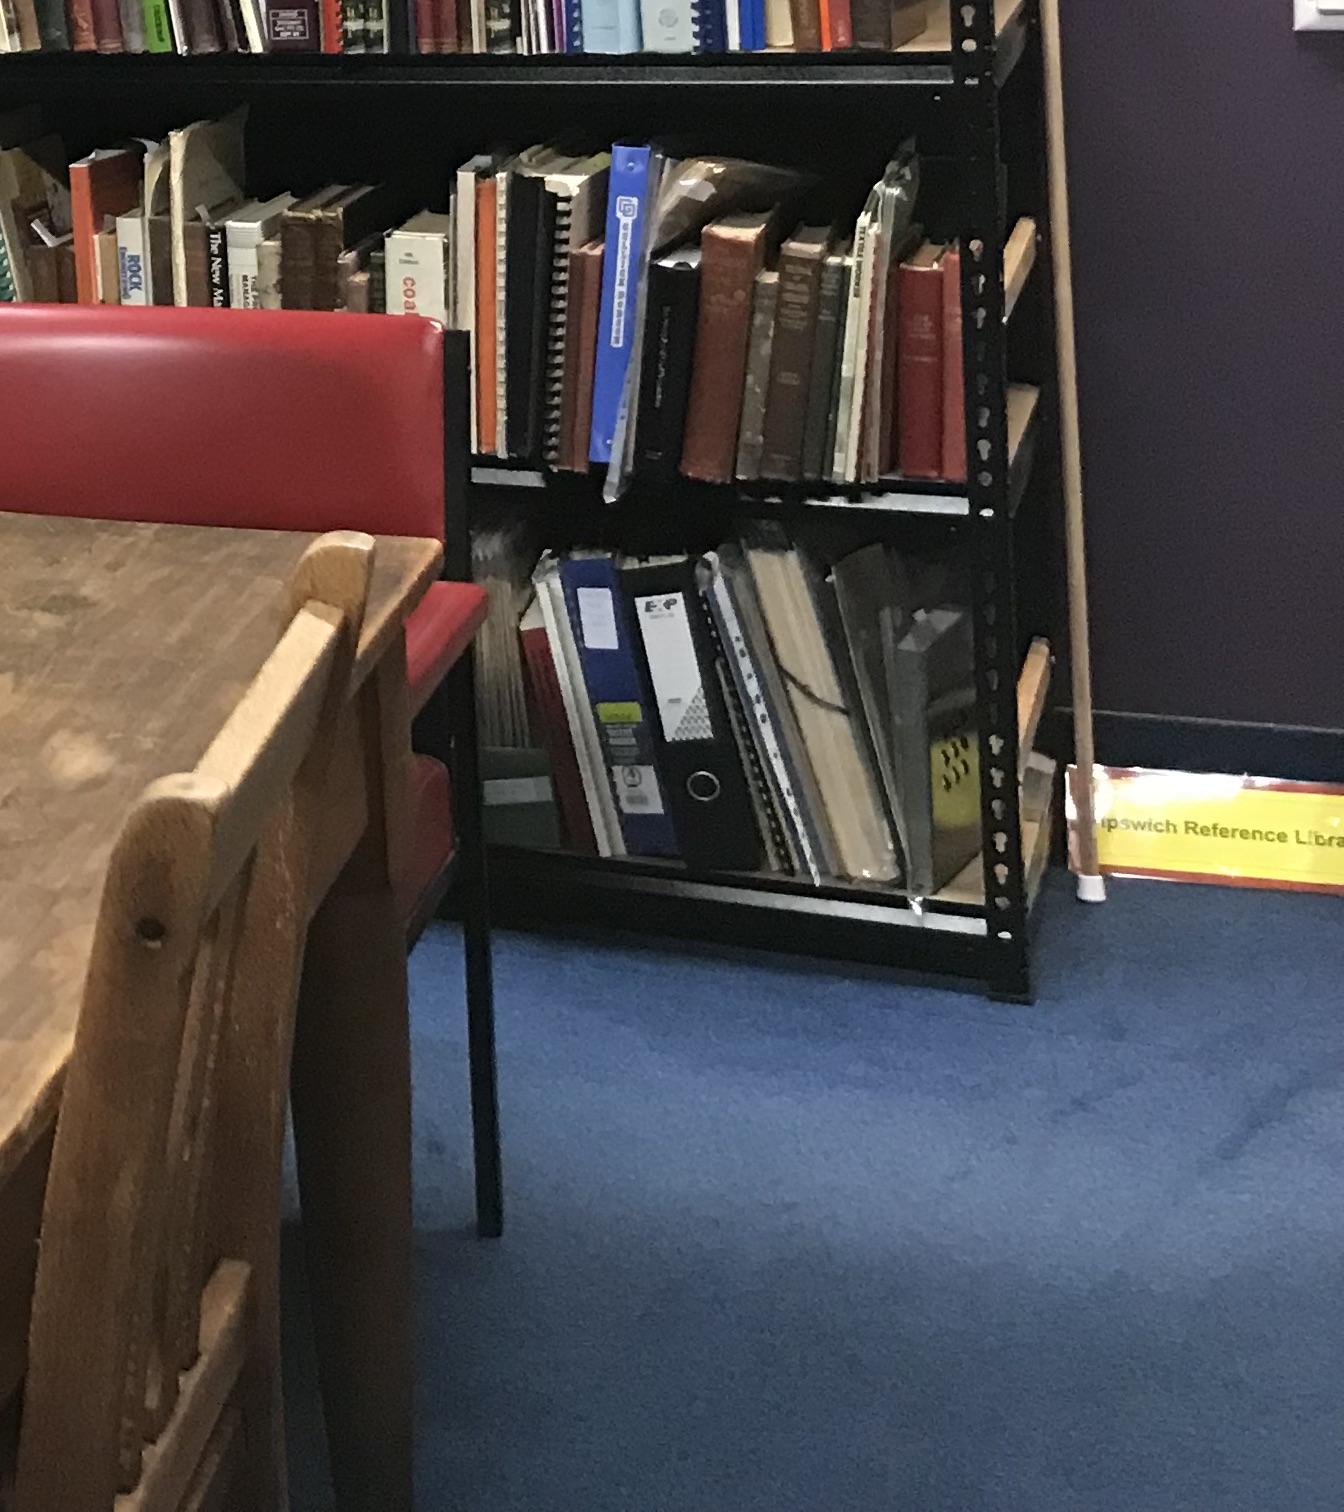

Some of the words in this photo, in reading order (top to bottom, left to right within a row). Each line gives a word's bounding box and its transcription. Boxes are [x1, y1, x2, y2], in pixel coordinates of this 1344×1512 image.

[210, 232, 221, 254] The
[128, 254, 143, 291] ROCK
[211, 257, 223, 284] New
[1100, 815, 1178, 835] Ipswich
[1184, 821, 1288, 843] Reference
[1295, 830, 1344, 848] Libra
